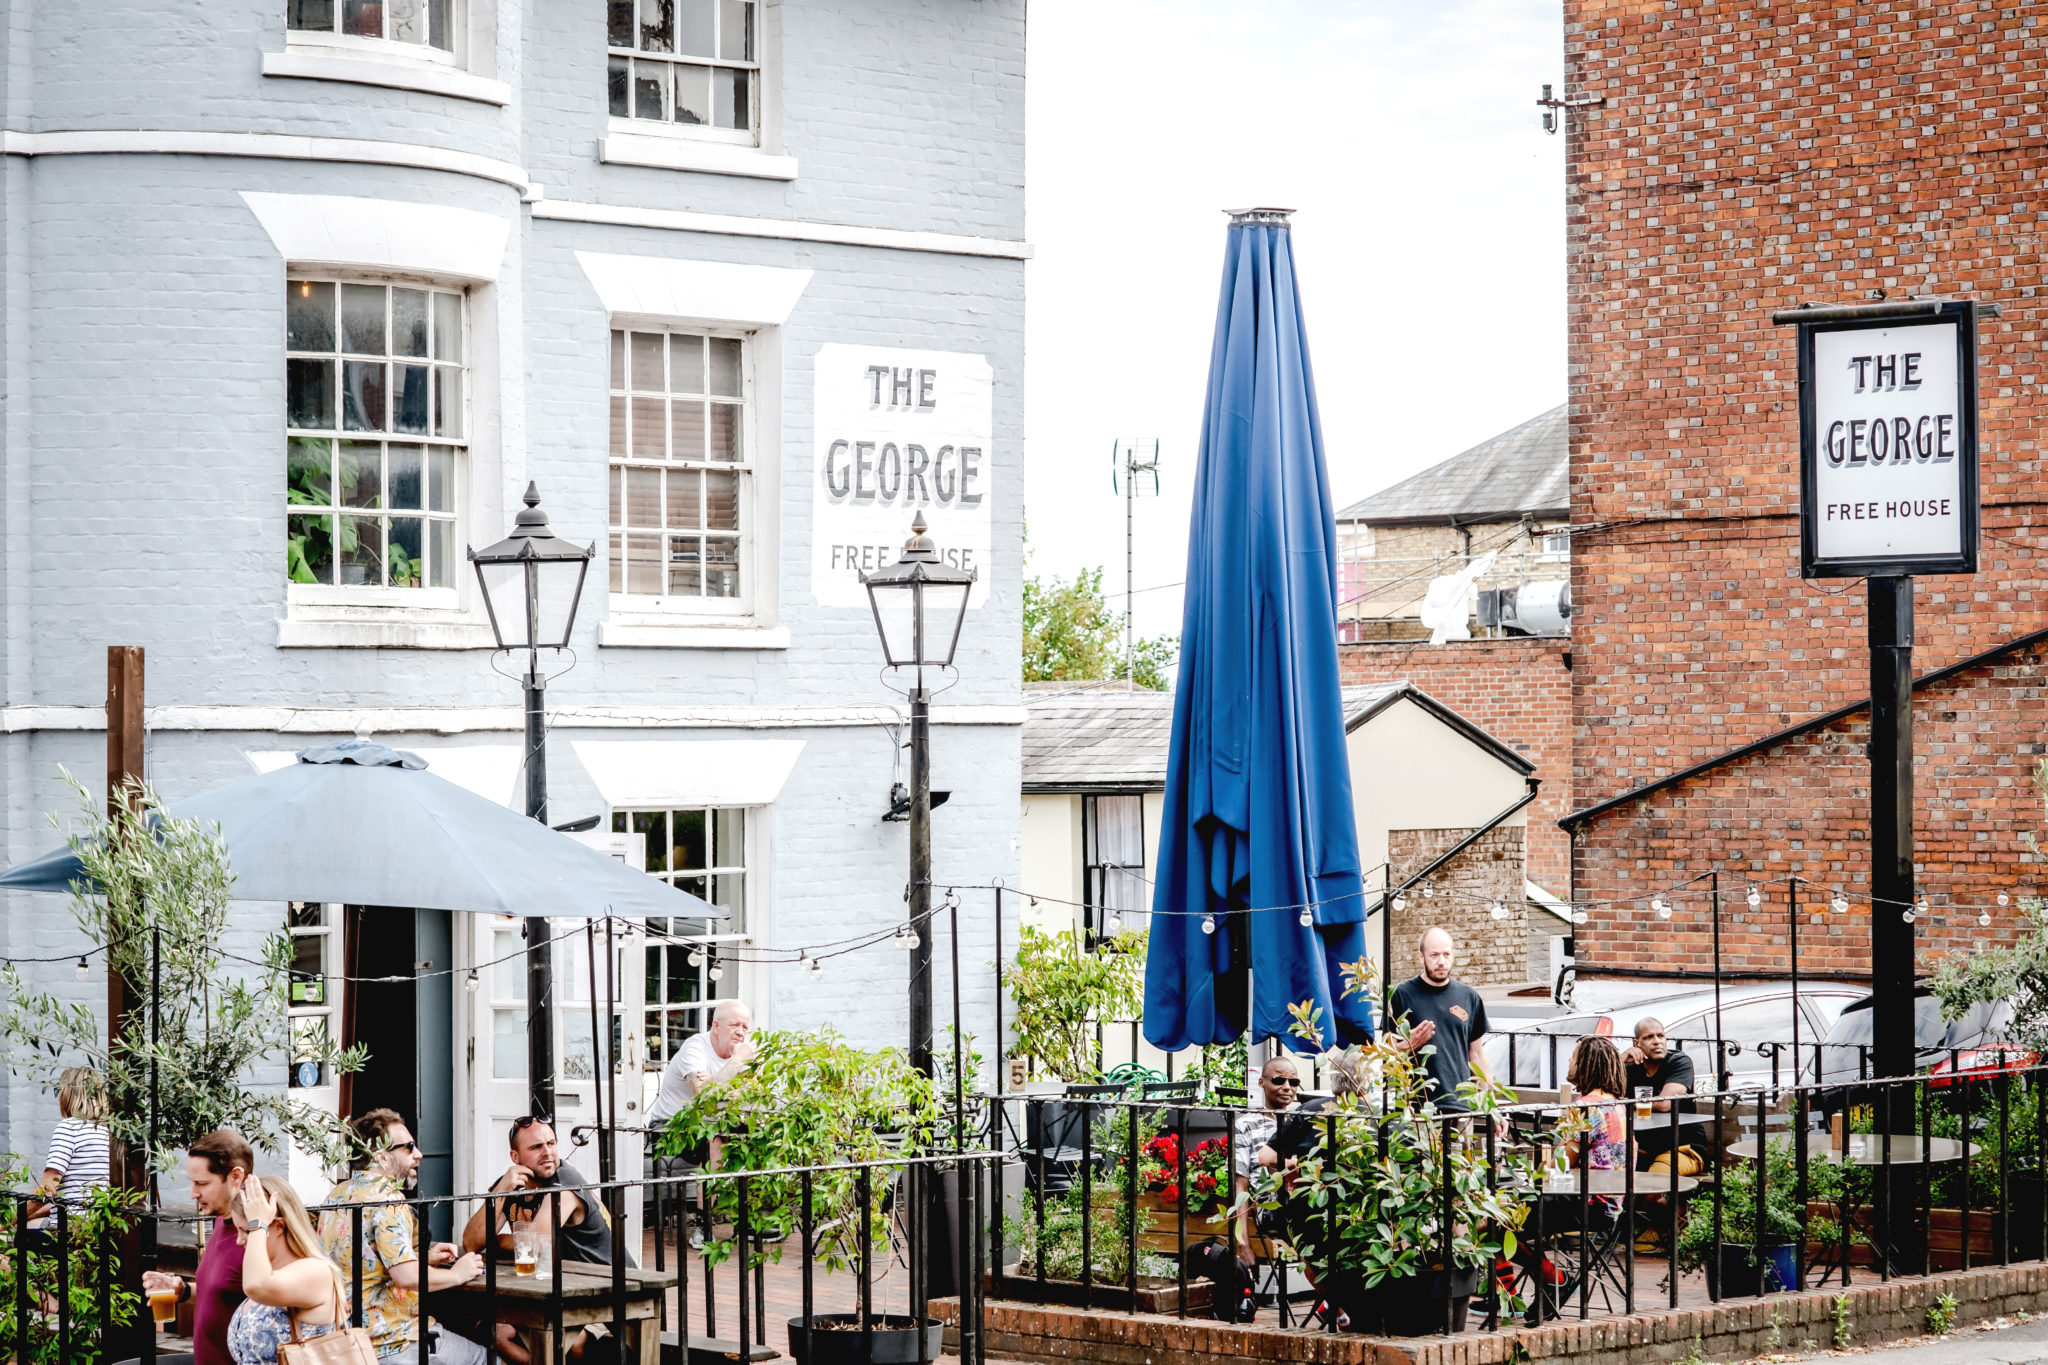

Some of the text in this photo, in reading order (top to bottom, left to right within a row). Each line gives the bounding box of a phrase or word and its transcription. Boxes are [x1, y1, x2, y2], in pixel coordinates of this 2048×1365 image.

[865, 365, 937, 413] THE
[1848, 353, 1922, 393] THE
[1822, 415, 1954, 469] GEORGE
[821, 440, 983, 509] GEORGE
[1827, 499, 1951, 521] FREE HOUSE
[831, 545, 889, 570] FREE
[1011, 1065, 1024, 1085] 5
